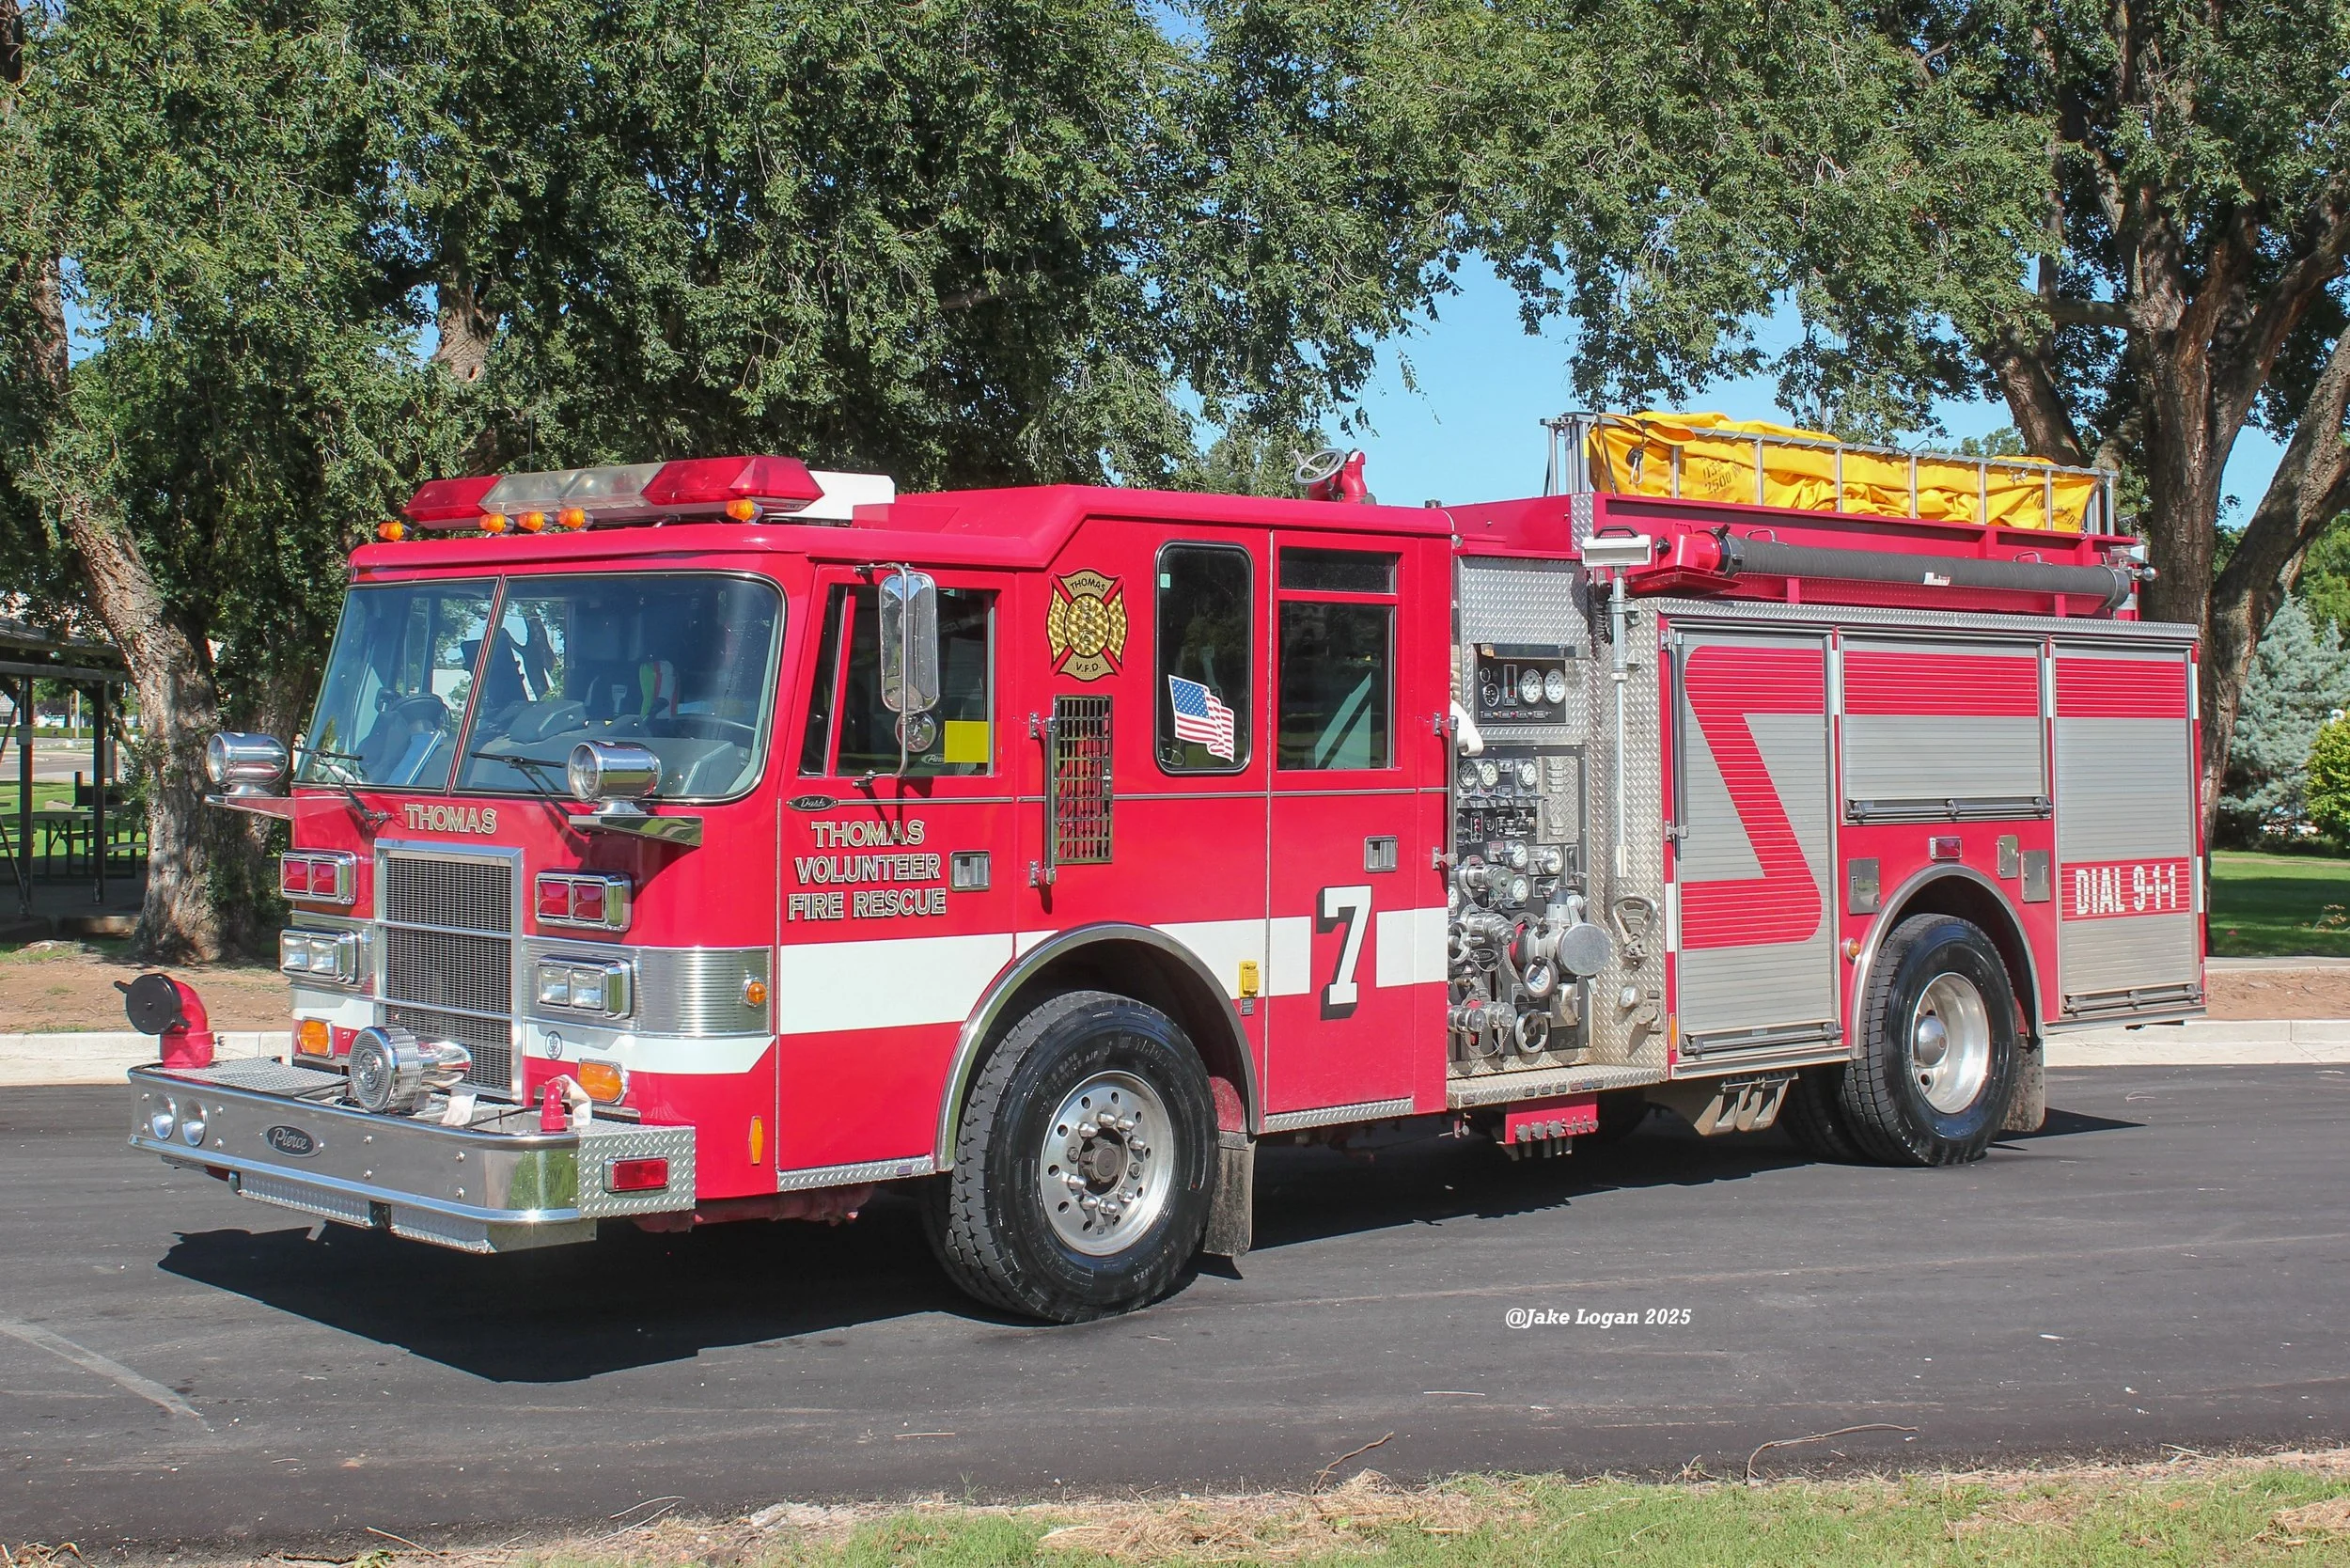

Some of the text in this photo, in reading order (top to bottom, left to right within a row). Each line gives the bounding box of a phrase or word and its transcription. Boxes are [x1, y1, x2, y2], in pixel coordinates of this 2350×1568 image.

[1069, 577, 1106, 593] THOMAS
[1075, 661, 1102, 673] V.F.D.
[800, 797, 826, 808] Dash
[404, 803, 497, 835] THOMAS
[810, 819, 926, 848] THOMAS
[794, 853, 941, 884] VOLUNTEER
[788, 887, 947, 921] FIRE RESCUE
[2075, 863, 2177, 916] DIAL 9-1-1
[1320, 885, 1372, 1011] 7
[273, 1127, 308, 1150] Pierce
